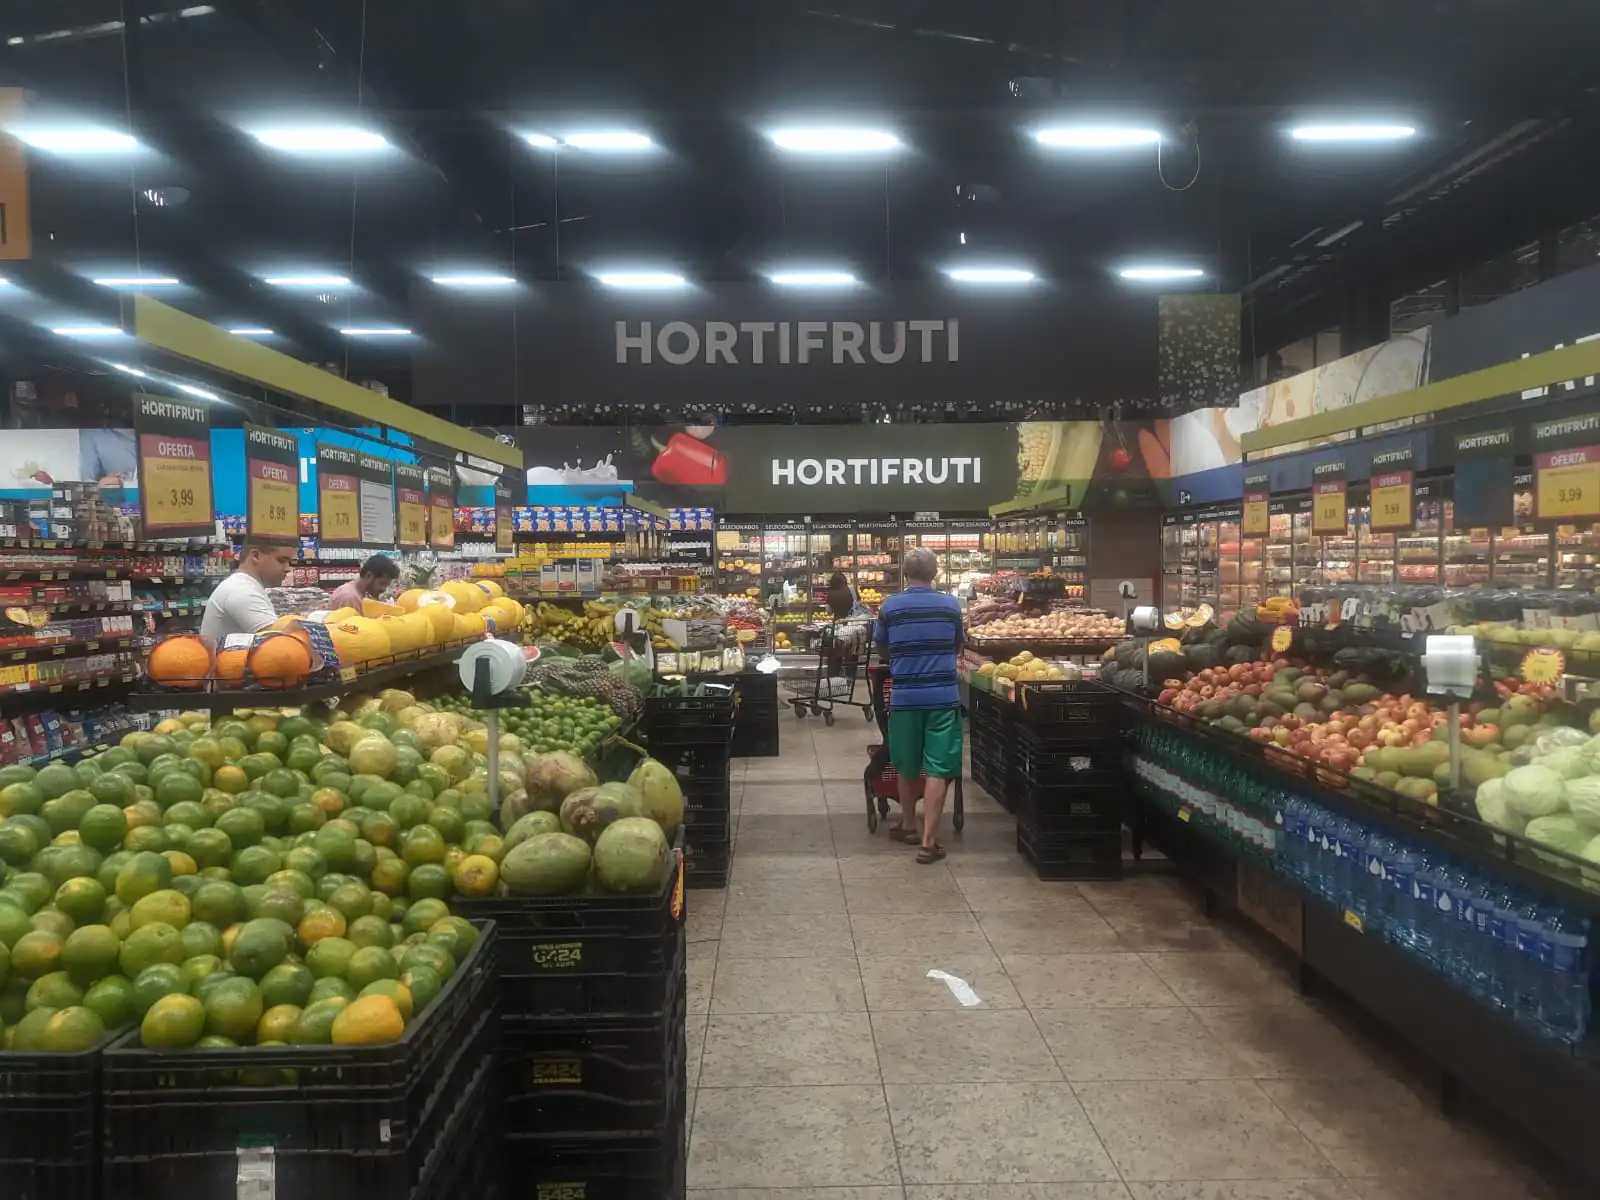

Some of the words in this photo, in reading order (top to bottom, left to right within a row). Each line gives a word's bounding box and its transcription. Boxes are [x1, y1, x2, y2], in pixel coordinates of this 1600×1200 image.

[615, 319, 960, 365] HORTIFRUTI
[141, 398, 205, 422] HORTIFRUTI
[1537, 418, 1599, 439] HORTIFRUTI
[249, 429, 295, 452] HORTIFRUTI
[1458, 433, 1509, 450] HORTIFRUTI
[158, 442, 195, 458] OFERTA
[320, 447, 356, 464] HORTIFRUTI
[1373, 450, 1412, 465] HORTIFRUTI
[1550, 453, 1587, 467] OFERTA
[262, 466, 288, 481] OFERTA
[772, 457, 981, 485] HORTIFRUTI
[171, 489, 194, 508] 3,99
